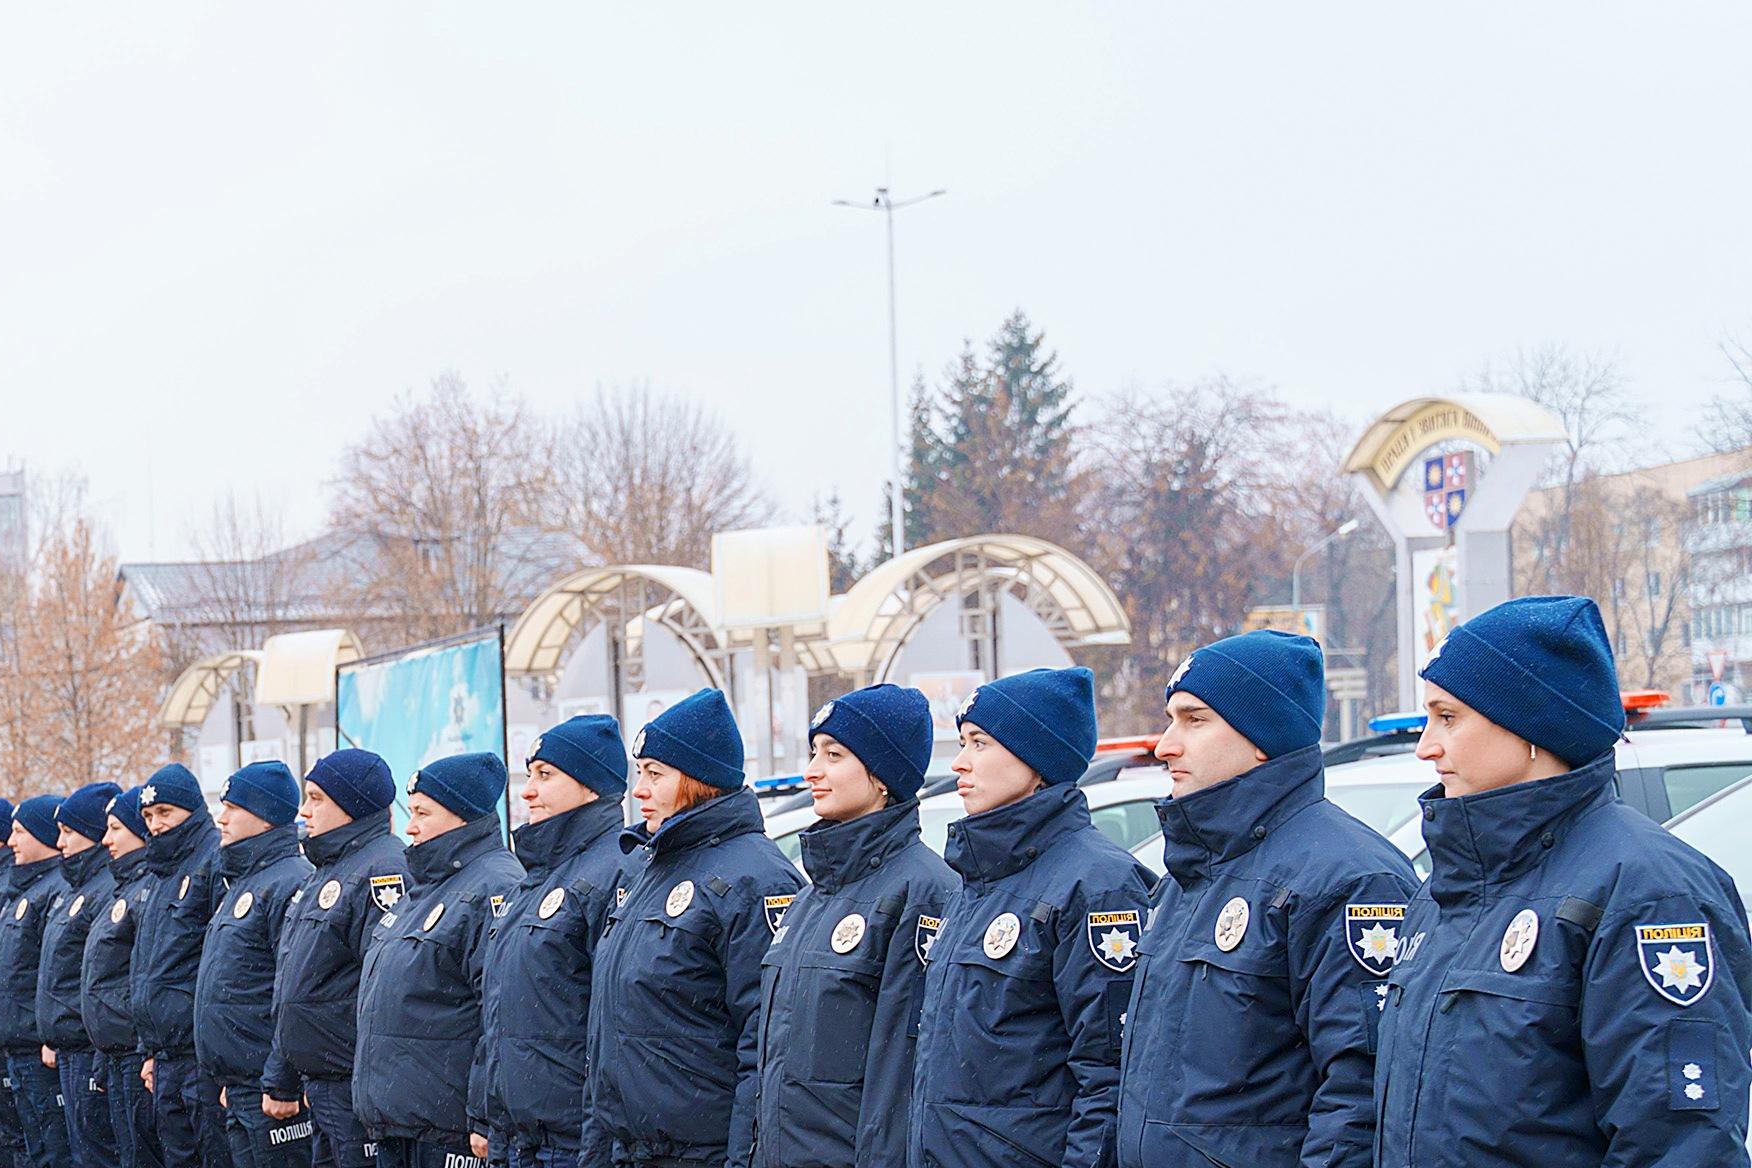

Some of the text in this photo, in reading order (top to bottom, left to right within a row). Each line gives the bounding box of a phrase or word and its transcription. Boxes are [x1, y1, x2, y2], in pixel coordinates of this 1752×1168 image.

[768, 897, 794, 906] ПОЛІЦ
[1351, 907, 1404, 917] ПОЛІЦІЯ
[1092, 913, 1134, 924] ПОЛІЦІЯ
[1643, 926, 1702, 939] ПОЛІЦІЯ
[269, 1120, 314, 1145] ПОЛІЦІЯ
